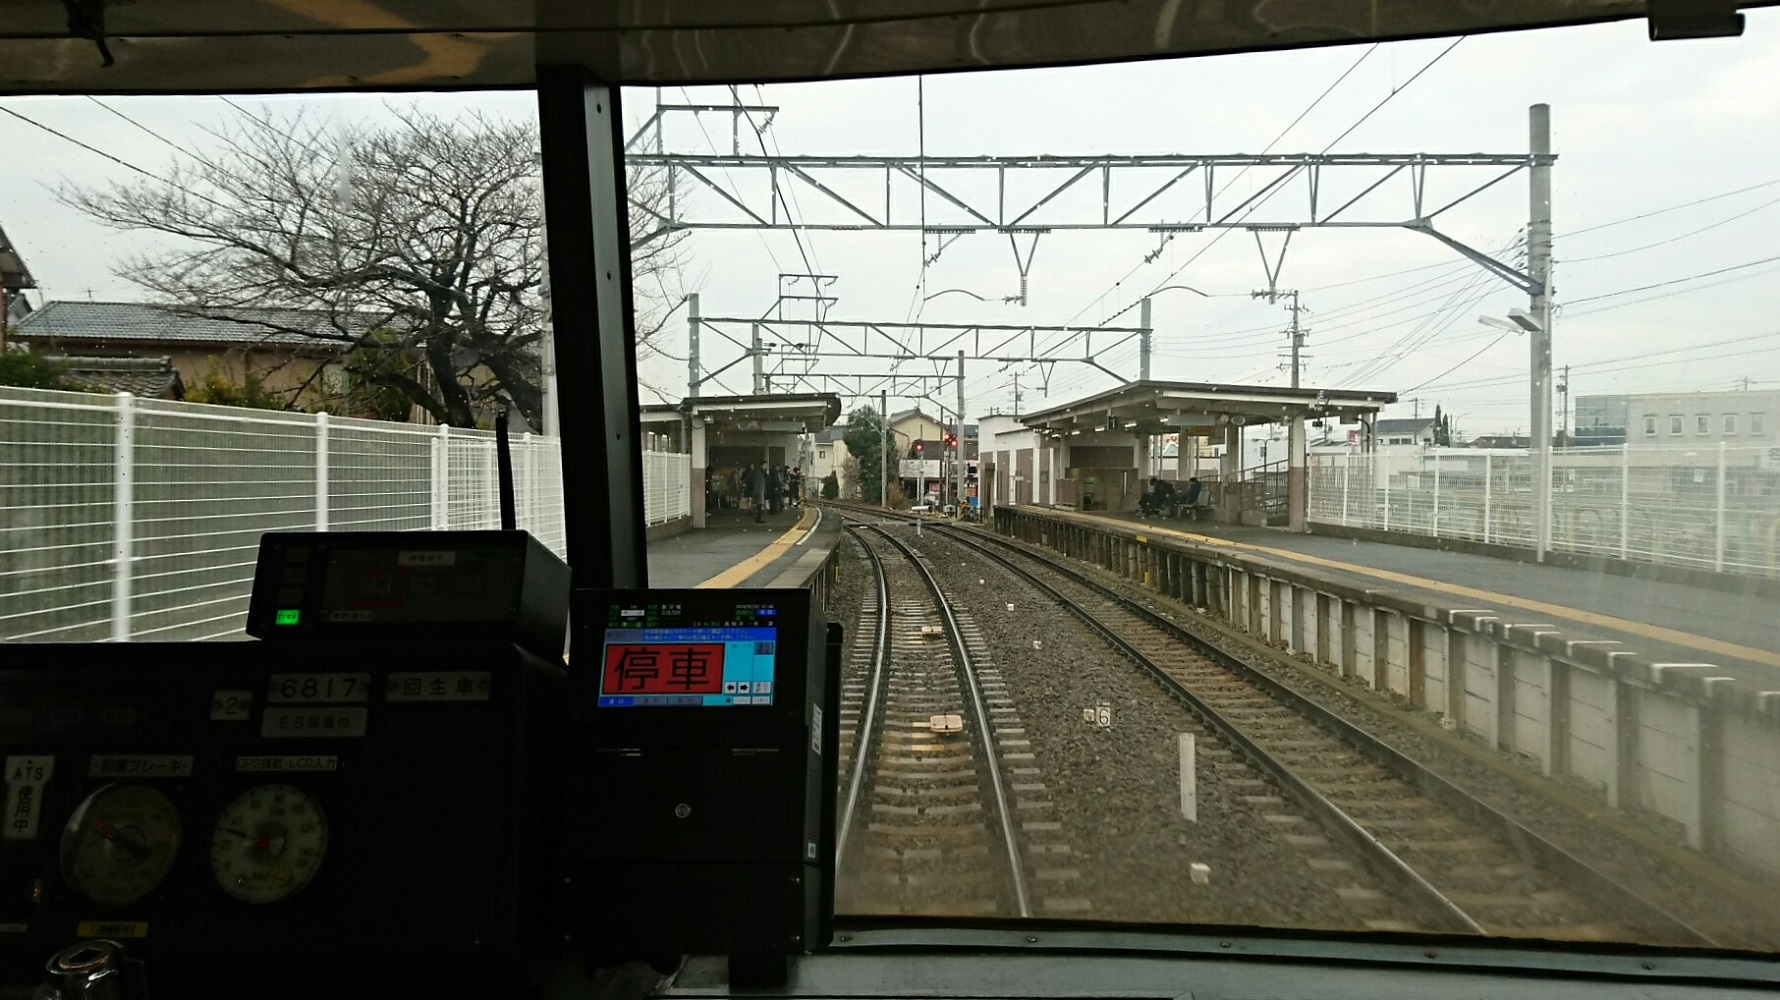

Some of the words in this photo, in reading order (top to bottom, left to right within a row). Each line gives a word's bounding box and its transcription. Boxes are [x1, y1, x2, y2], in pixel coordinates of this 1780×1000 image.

[613, 647, 712, 691] 停車
[280, 678, 358, 698] 6817
[403, 677, 474, 696] 回生車
[225, 697, 238, 715] 2
[1099, 709, 1109, 725] 6
[13, 766, 44, 781] ATS
[13, 785, 34, 833] 使用中
